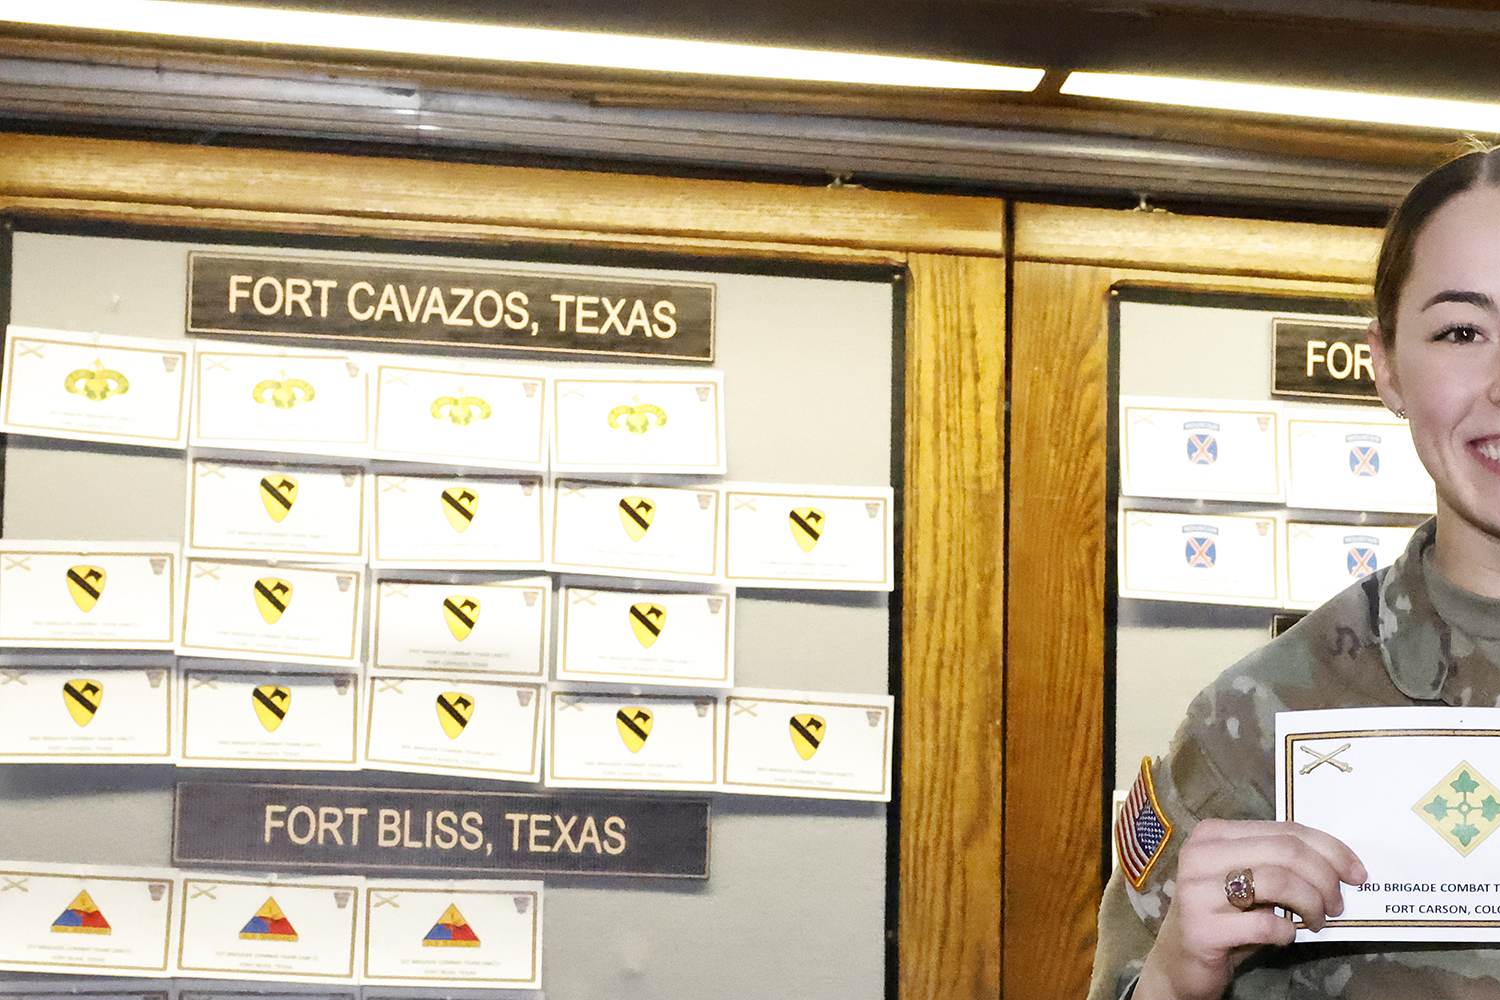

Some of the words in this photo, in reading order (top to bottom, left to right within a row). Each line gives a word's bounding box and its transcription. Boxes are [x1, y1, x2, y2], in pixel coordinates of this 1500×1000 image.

[228, 274, 338, 318] FORT
[346, 280, 539, 335] CAVAZOS,
[551, 292, 677, 339] TEXAS
[1306, 339, 1376, 381] FOR
[264, 804, 368, 847] FORT
[377, 809, 493, 855] BLISS,
[504, 812, 627, 855] TEXAS
[1356, 882, 1381, 893] 3RD
[1384, 883, 1437, 893] BRIGADE
[1440, 883, 1491, 893] COMBAT
[1385, 904, 1415, 914] FORT
[1418, 904, 1471, 916] CARSON,
